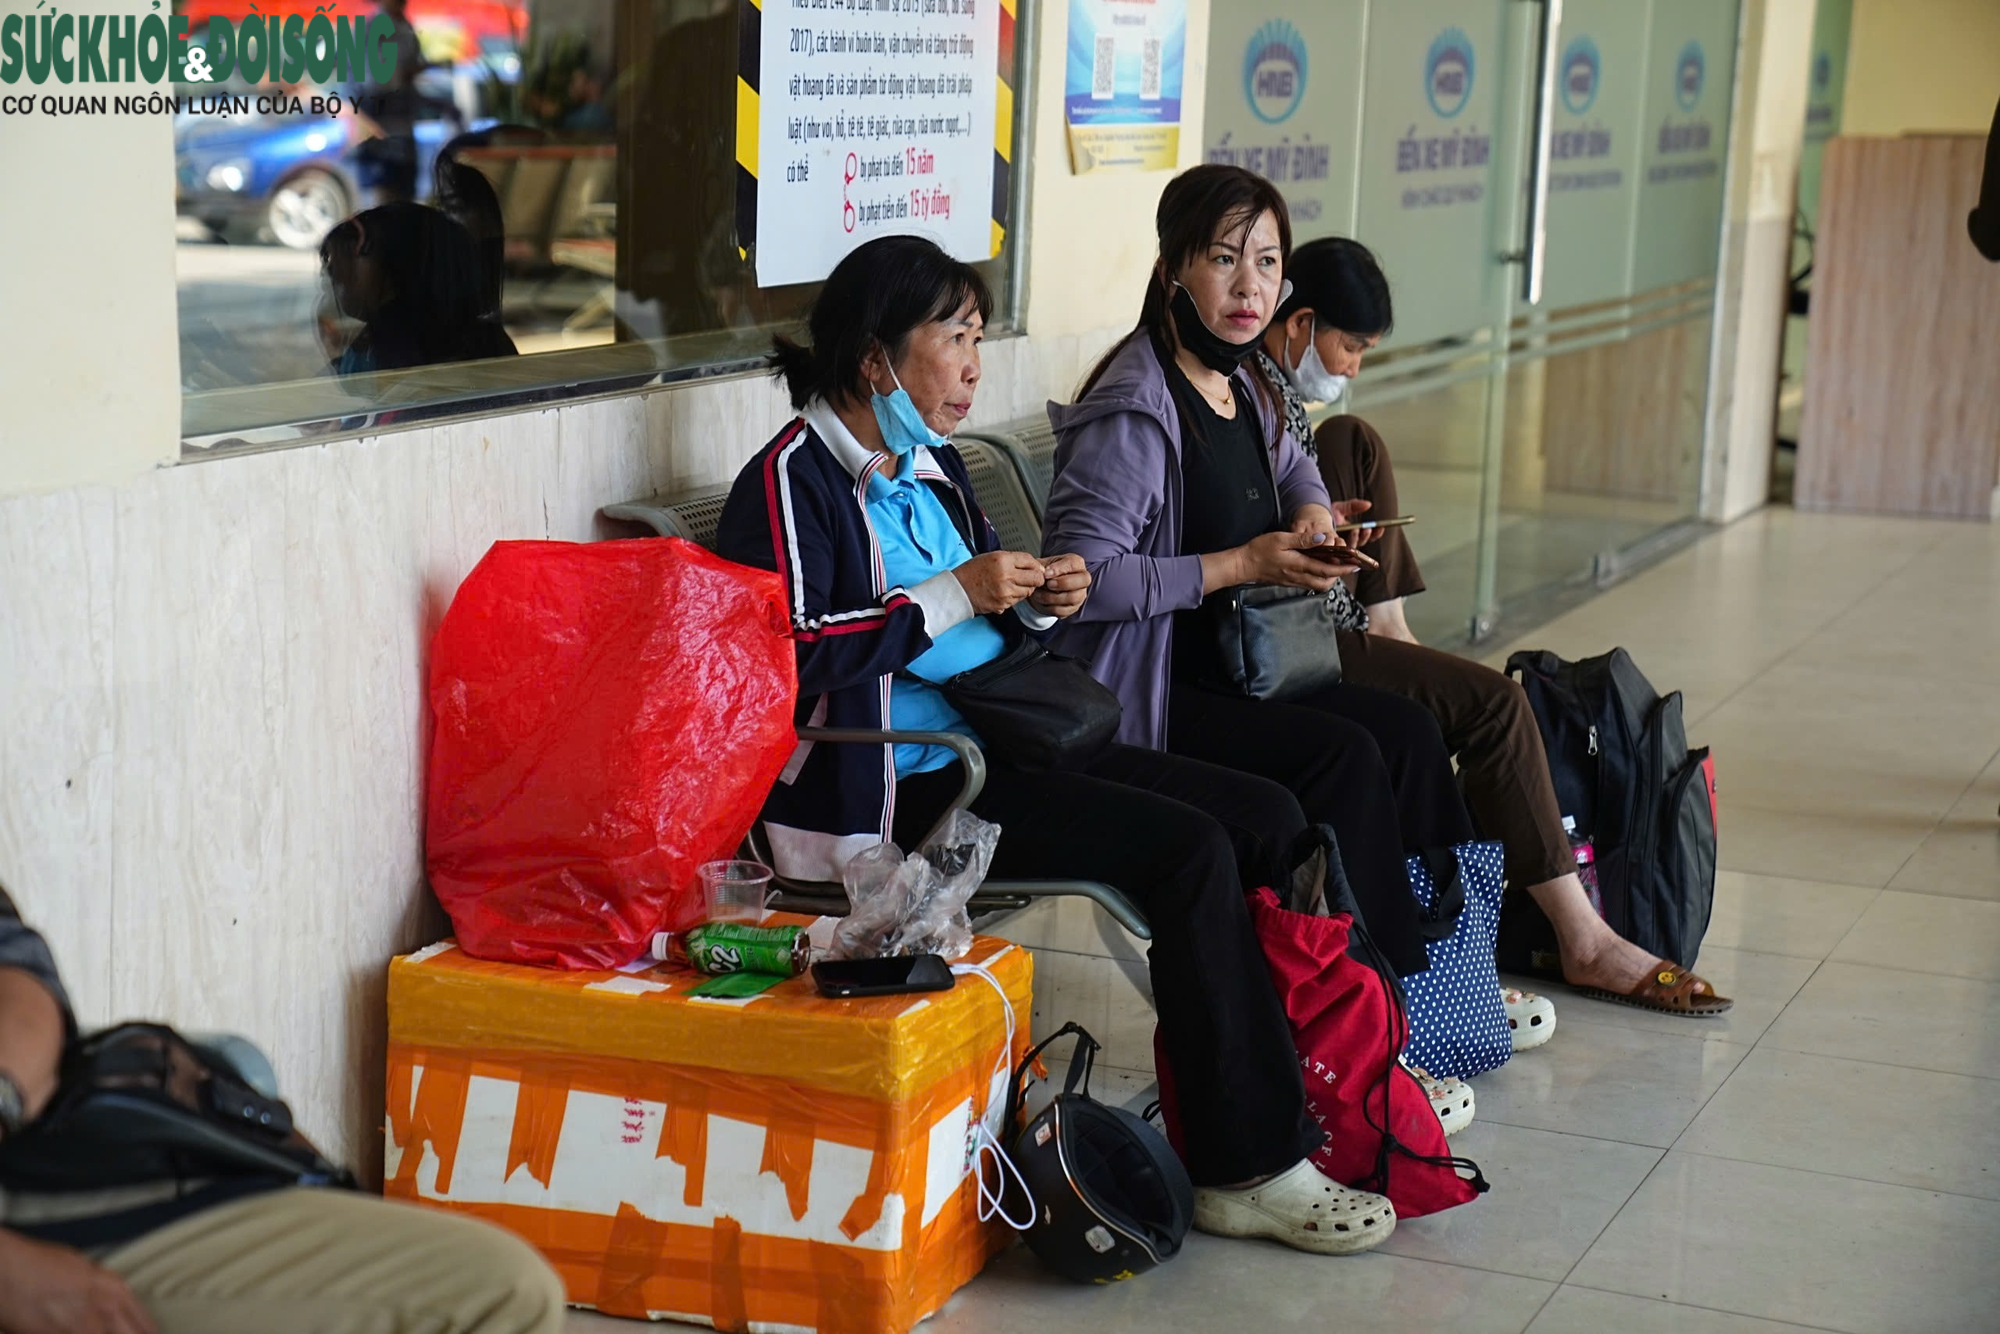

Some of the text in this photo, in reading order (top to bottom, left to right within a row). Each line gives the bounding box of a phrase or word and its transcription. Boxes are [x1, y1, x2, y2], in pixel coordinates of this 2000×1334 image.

[790, 28, 815, 57] 2017),
[816, 31, 828, 53] các
[829, 30, 847, 53] hành
[856, 29, 872, 53] buôn
[873, 30, 887, 57] bán,
[888, 32, 901, 58] vận
[901, 26, 924, 58] chuyển
[925, 32, 933, 53] và
[959, 33, 974, 59] động
[788, 73, 801, 101] vật
[802, 72, 824, 101] hoang
[825, 72, 834, 95] dã
[836, 73, 845, 95] và
[846, 72, 858, 95] sản
[859, 66, 877, 100] phẩm
[879, 73, 887, 95] từ
[888, 72, 904, 100] động
[905, 72, 917, 100] vật
[917, 72, 936, 99] hoang
[937, 72, 945, 94] dã
[958, 72, 973, 98] pháp
[787, 115, 802, 144] luật
[803, 115, 820, 144] (như
[821, 117, 834, 142] voi,
[836, 108, 847, 142] hổ,
[848, 115, 855, 137] tê
[856, 116, 867, 141] tê,
[867, 115, 875, 136] tê
[875, 114, 892, 142] giác,
[892, 114, 903, 135] rùa
[904, 119, 918, 140] cạn,
[918, 113, 929, 134] rùa
[929, 112, 945, 134] nước
[786, 152, 809, 183] có thể
[860, 147, 934, 182] bị phạt tù đến 15 năm
[859, 182, 950, 226] bị phạt tiền đến 15 tỷ đồng
